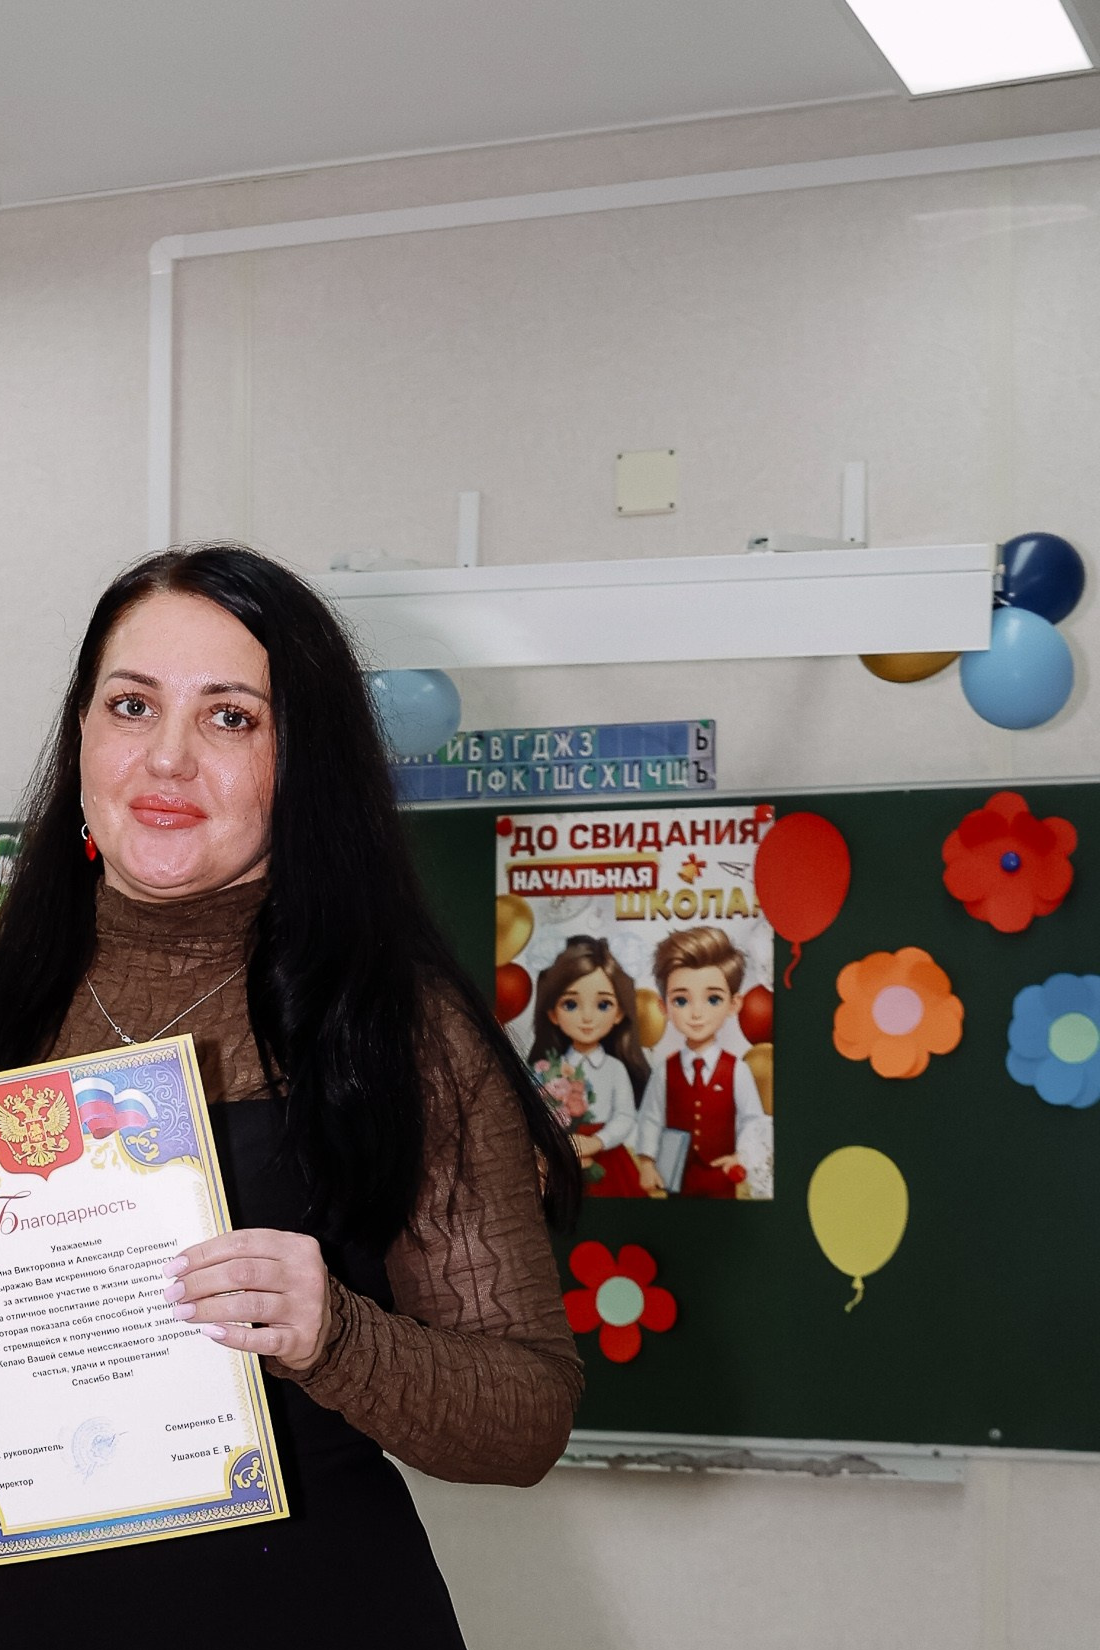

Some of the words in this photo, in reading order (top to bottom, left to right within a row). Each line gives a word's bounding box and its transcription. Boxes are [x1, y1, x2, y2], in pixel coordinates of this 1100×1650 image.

[510, 825, 558, 856] ДО
[569, 819, 760, 852] СВИДАНИЯ
[512, 867, 653, 891] НАЧАЛЬНАЯ
[14, 1260, 67, 1275] Викторовна
[76, 1250, 125, 1265] Александр
[126, 1239, 178, 1255] Сергеевич!
[50, 1238, 103, 1254] Уважаемые
[35, 1278, 54, 1287] Вам
[55, 1268, 108, 1283] искреннюю
[4, 1299, 14, 1307] за
[14, 1292, 55, 1305] активное
[56, 1286, 91, 1300] участие
[101, 1280, 130, 1290] жизни
[5, 1309, 47, 1322] отличное
[48, 1300, 101, 1315] воспитание
[102, 1294, 136, 1307] дочери
[138, 1288, 166, 1299] Ангел
[30, 1320, 71, 1333] показала
[72, 1315, 94, 1326] себя
[95, 1308, 145, 1322] способной
[3, 1337, 62, 1353] стремящейся
[69, 1327, 121, 1342] получению
[122, 1321, 153, 1333] новых
[154, 1318, 184, 1327] знан
[27, 1352, 57, 1364] Вашей
[58, 1349, 86, 1360] семье
[87, 1336, 156, 1354] неиссякаемого
[71, 1362, 99, 1374] удачи
[99, 1360, 107, 1368] и
[107, 1347, 170, 1367] процветания!
[71, 1374, 111, 1387] Спасибо
[112, 1369, 134, 1381] Вам!
[3, 1444, 65, 1460] руководитель
[165, 1418, 217, 1433] Семиренко
[170, 1450, 212, 1463] Ушакова
